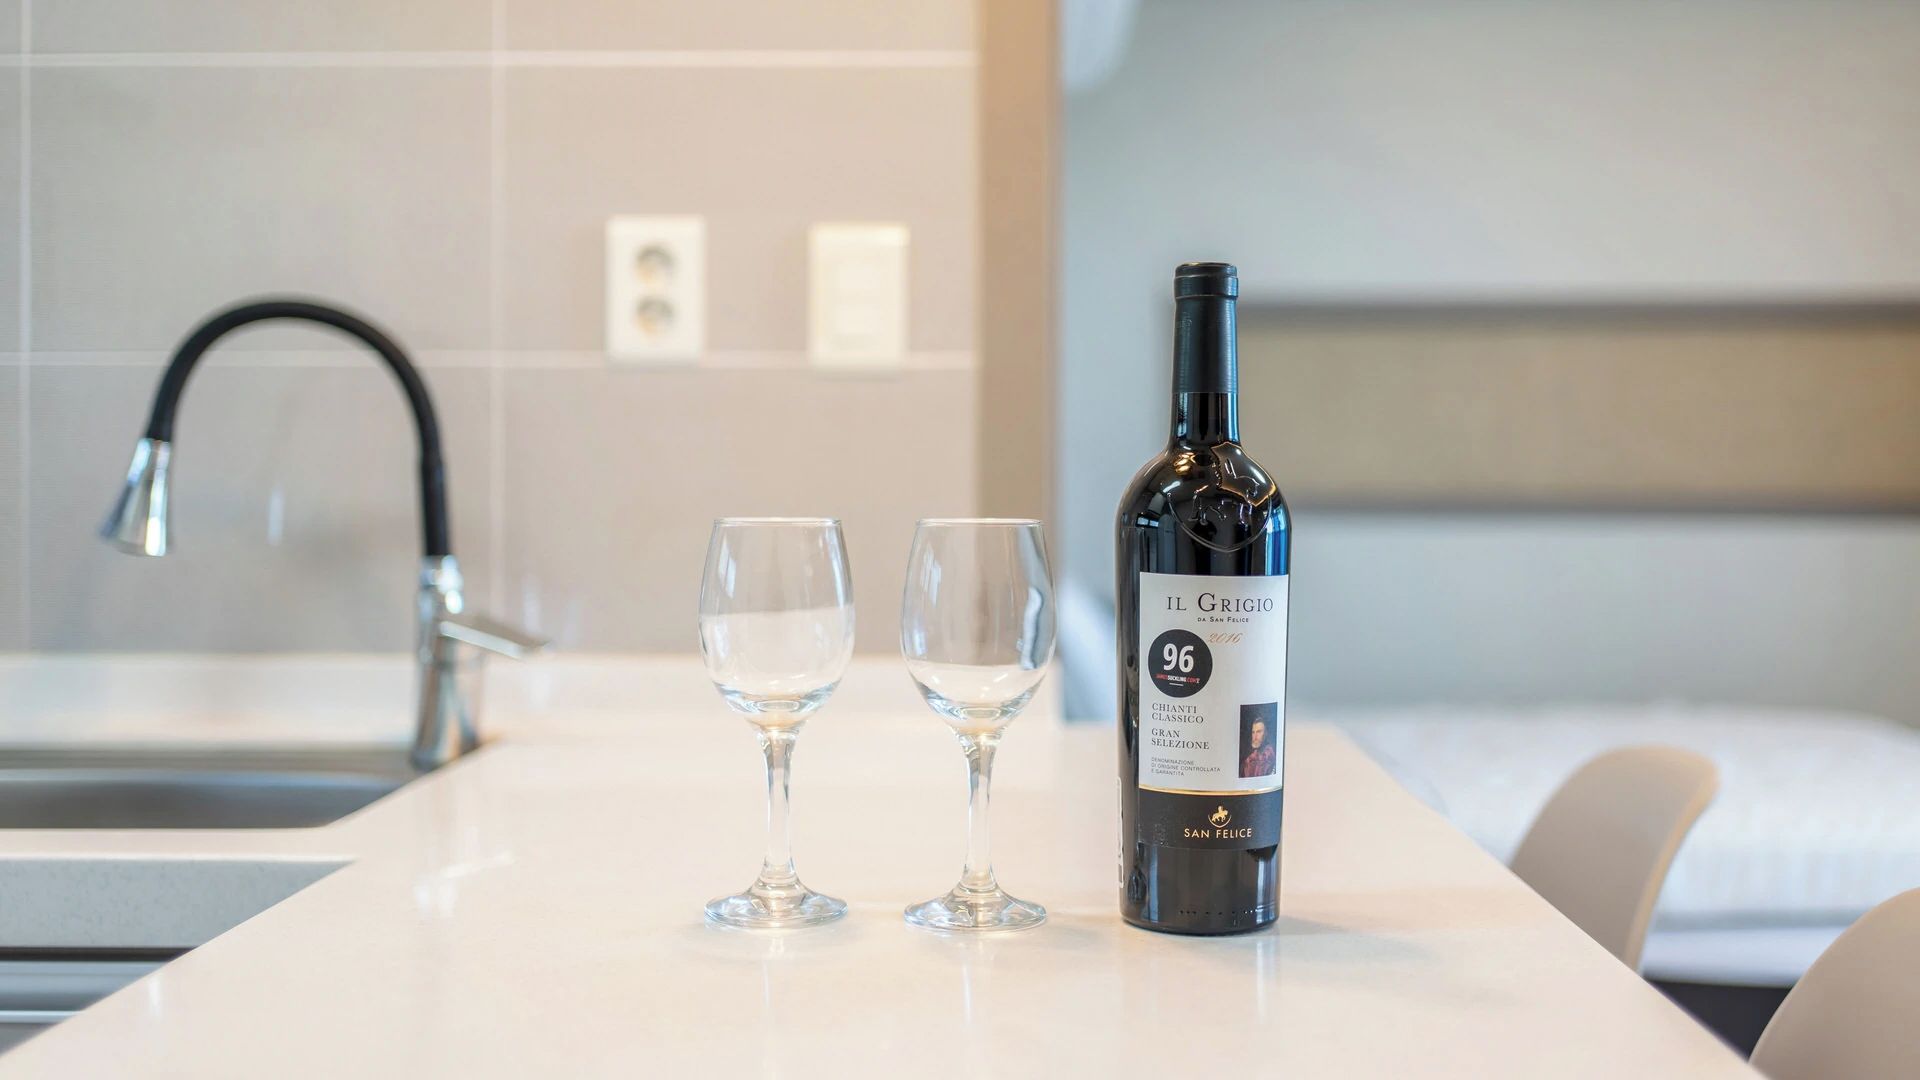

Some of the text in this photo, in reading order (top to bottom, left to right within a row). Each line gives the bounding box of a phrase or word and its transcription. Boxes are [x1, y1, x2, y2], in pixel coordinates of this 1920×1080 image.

[1167, 592, 1274, 613] IL GRIGIO
[1208, 632, 1243, 644] 2016
[1163, 643, 1194, 673] 96
[1151, 702, 1197, 714] CHIANTI
[1151, 713, 1204, 724] CLASSICO
[1151, 727, 1180, 738] GRAN
[1151, 738, 1210, 750] SELEZIONE
[1183, 828, 1252, 839] SAN FELICE
